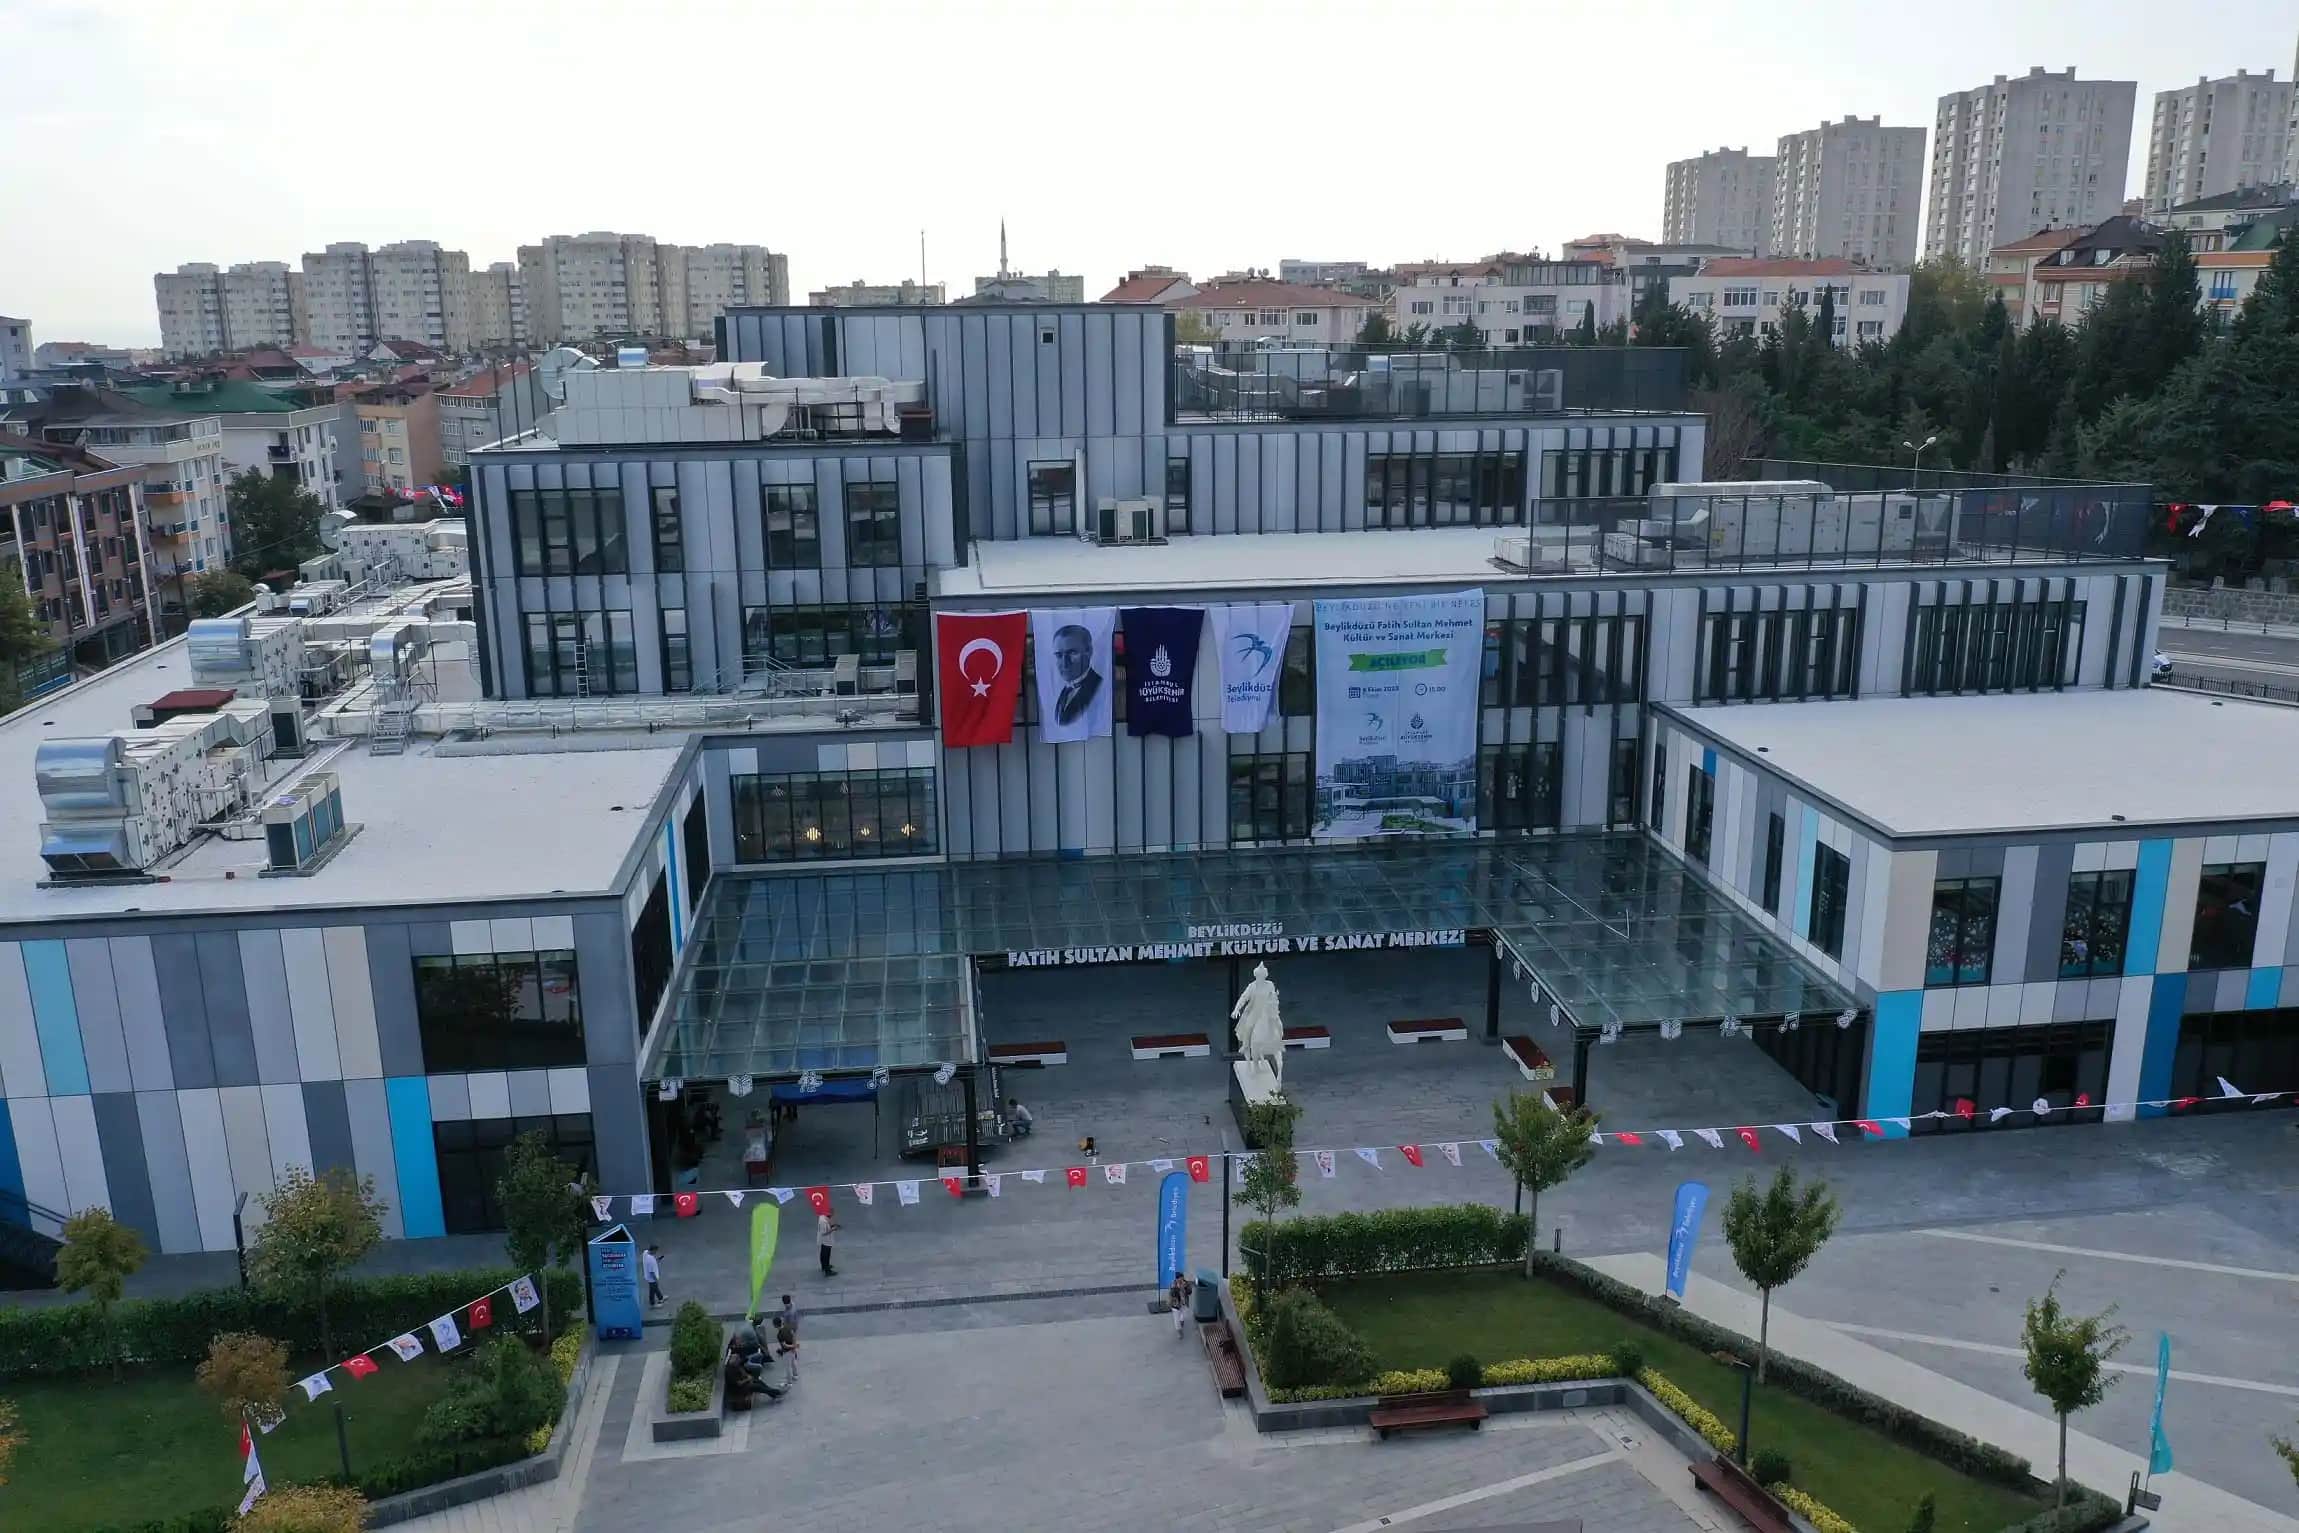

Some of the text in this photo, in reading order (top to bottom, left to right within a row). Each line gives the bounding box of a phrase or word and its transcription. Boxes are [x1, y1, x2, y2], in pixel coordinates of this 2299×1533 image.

[1377, 620, 1400, 630] Fatih
[1403, 619, 1432, 629] Sultan
[1435, 618, 1473, 628] Mehmet
[1343, 631, 1372, 643] Kültür
[1388, 631, 1414, 641] Sanat
[1416, 631, 1454, 641] Merkezi
[1187, 922, 1284, 939] BEYLİKDÜZÜ
[1008, 929, 1466, 967] FATİH SULTAN MEHMET KÜLTÜR VE SANAT MERKEZİ
